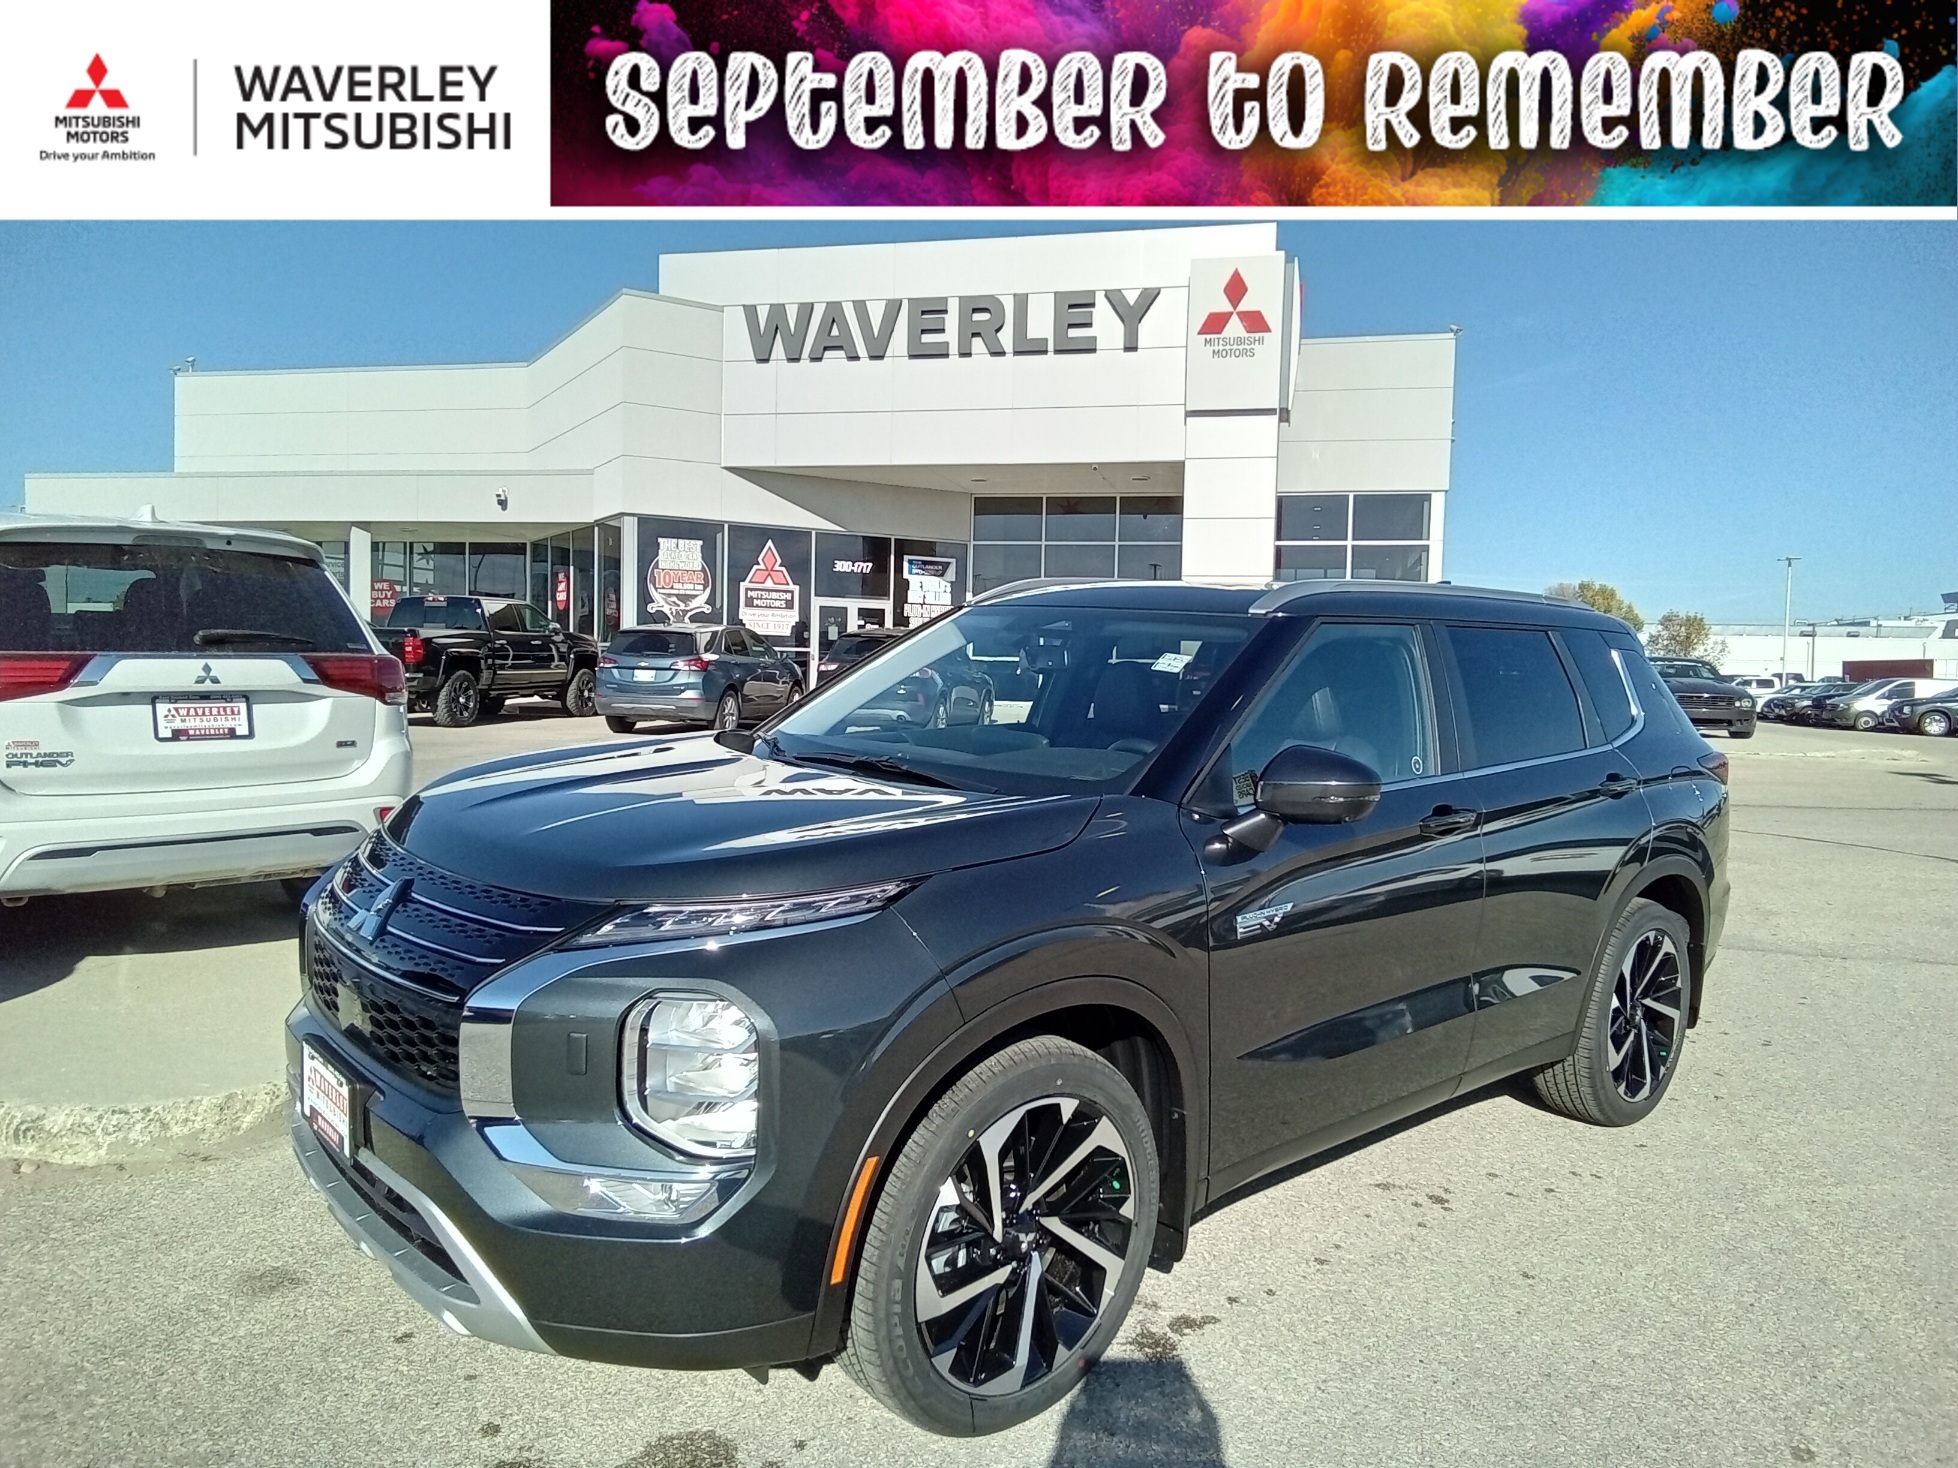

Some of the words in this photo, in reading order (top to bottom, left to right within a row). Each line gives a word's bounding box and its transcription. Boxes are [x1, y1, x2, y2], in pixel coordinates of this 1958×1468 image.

[743, 287, 1161, 363] WAVERLEY
[1203, 335, 1265, 348] MITSUBISHI
[1211, 347, 1256, 359] MOTORS
[657, 537, 677, 551] THE
[677, 539, 703, 552] BEST
[832, 560, 873, 574] 300-1717
[654, 569, 673, 588] 10
[672, 570, 704, 583] YEAR
[373, 582, 390, 590] WE
[372, 590, 393, 599] BUY
[747, 590, 792, 601] MITSUBISHI
[370, 599, 396, 607] CARS
[753, 598, 787, 608] MOTORS
[748, 621, 770, 630] SINCE
[177, 706, 240, 717] WAVERLEY
[180, 716, 241, 724] MITSUBISHI
[187, 728, 229, 736] WAVERLEY
[5, 751, 74, 759] OUTLANDER
